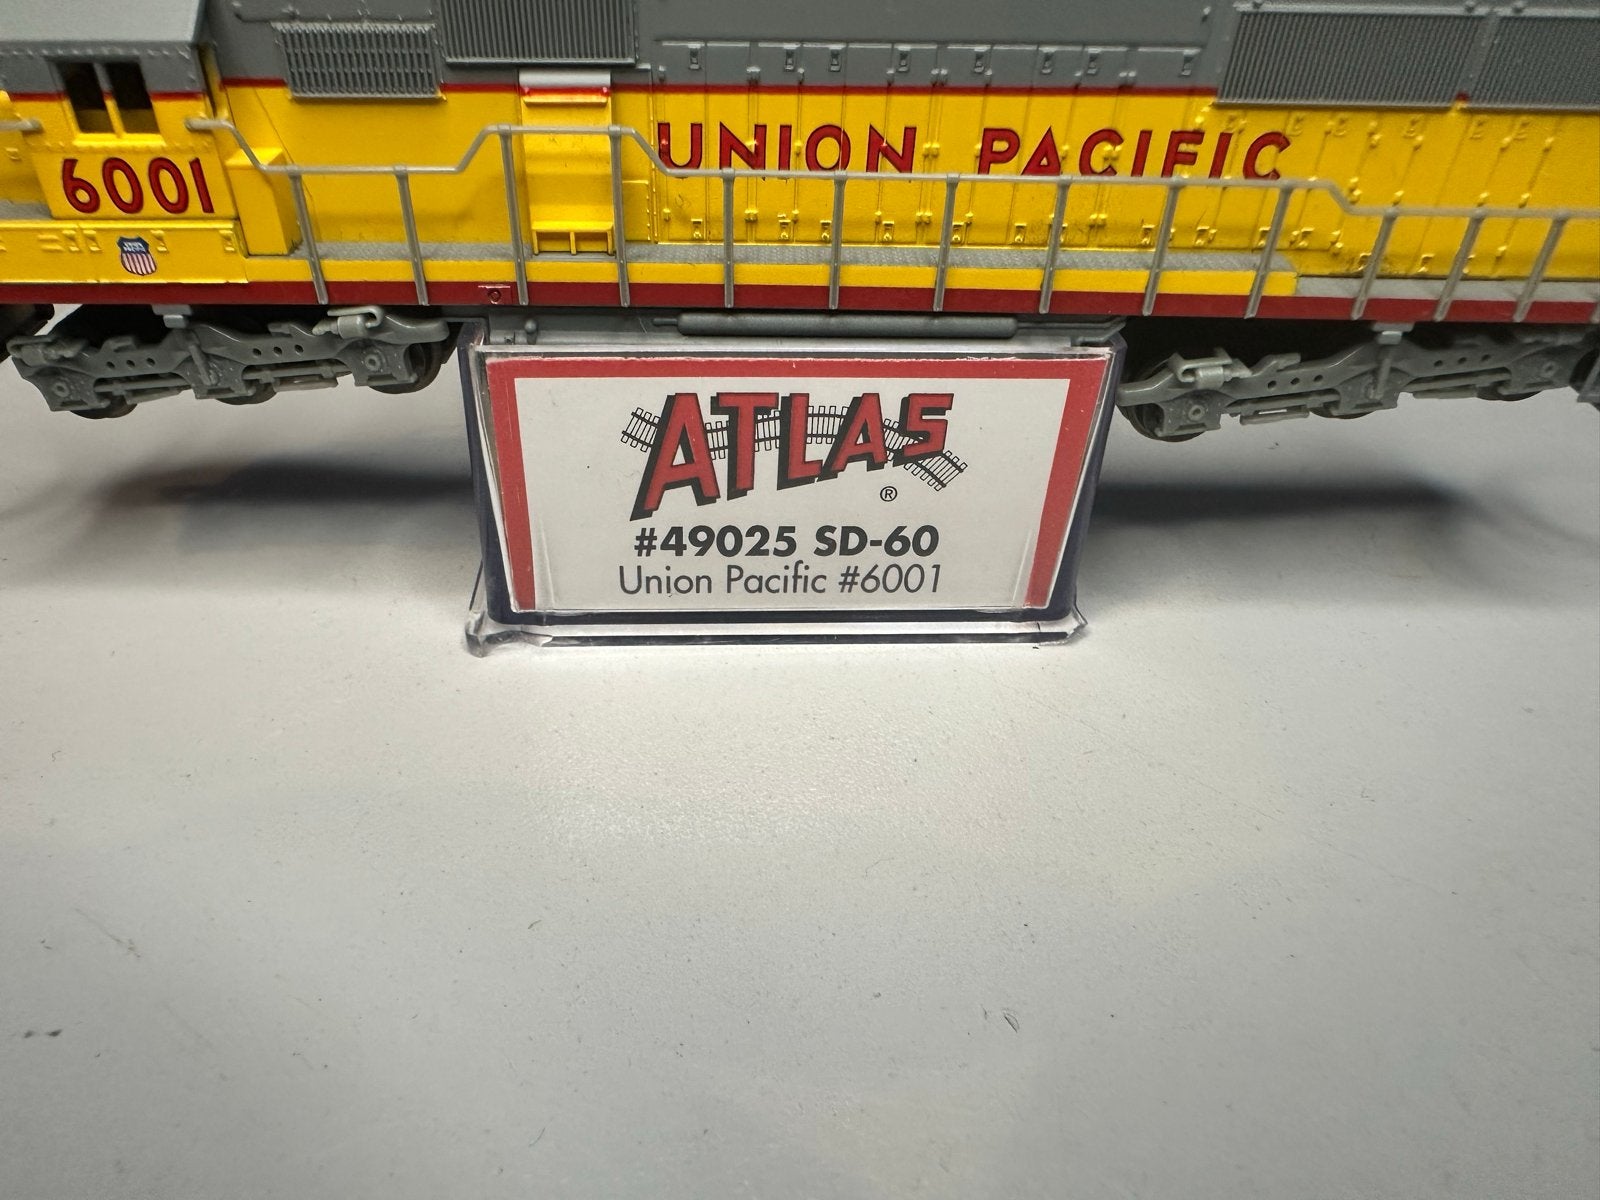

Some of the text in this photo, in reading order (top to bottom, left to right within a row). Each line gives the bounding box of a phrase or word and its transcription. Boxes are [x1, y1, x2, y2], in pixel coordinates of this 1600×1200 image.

[657, 121, 1291, 180] UNION PACIFIC
[61, 157, 215, 214] 6001
[630, 392, 954, 521] ATLAS
[634, 525, 940, 557] #49025 SD-60
[619, 560, 941, 594] Union Pacific #6001
